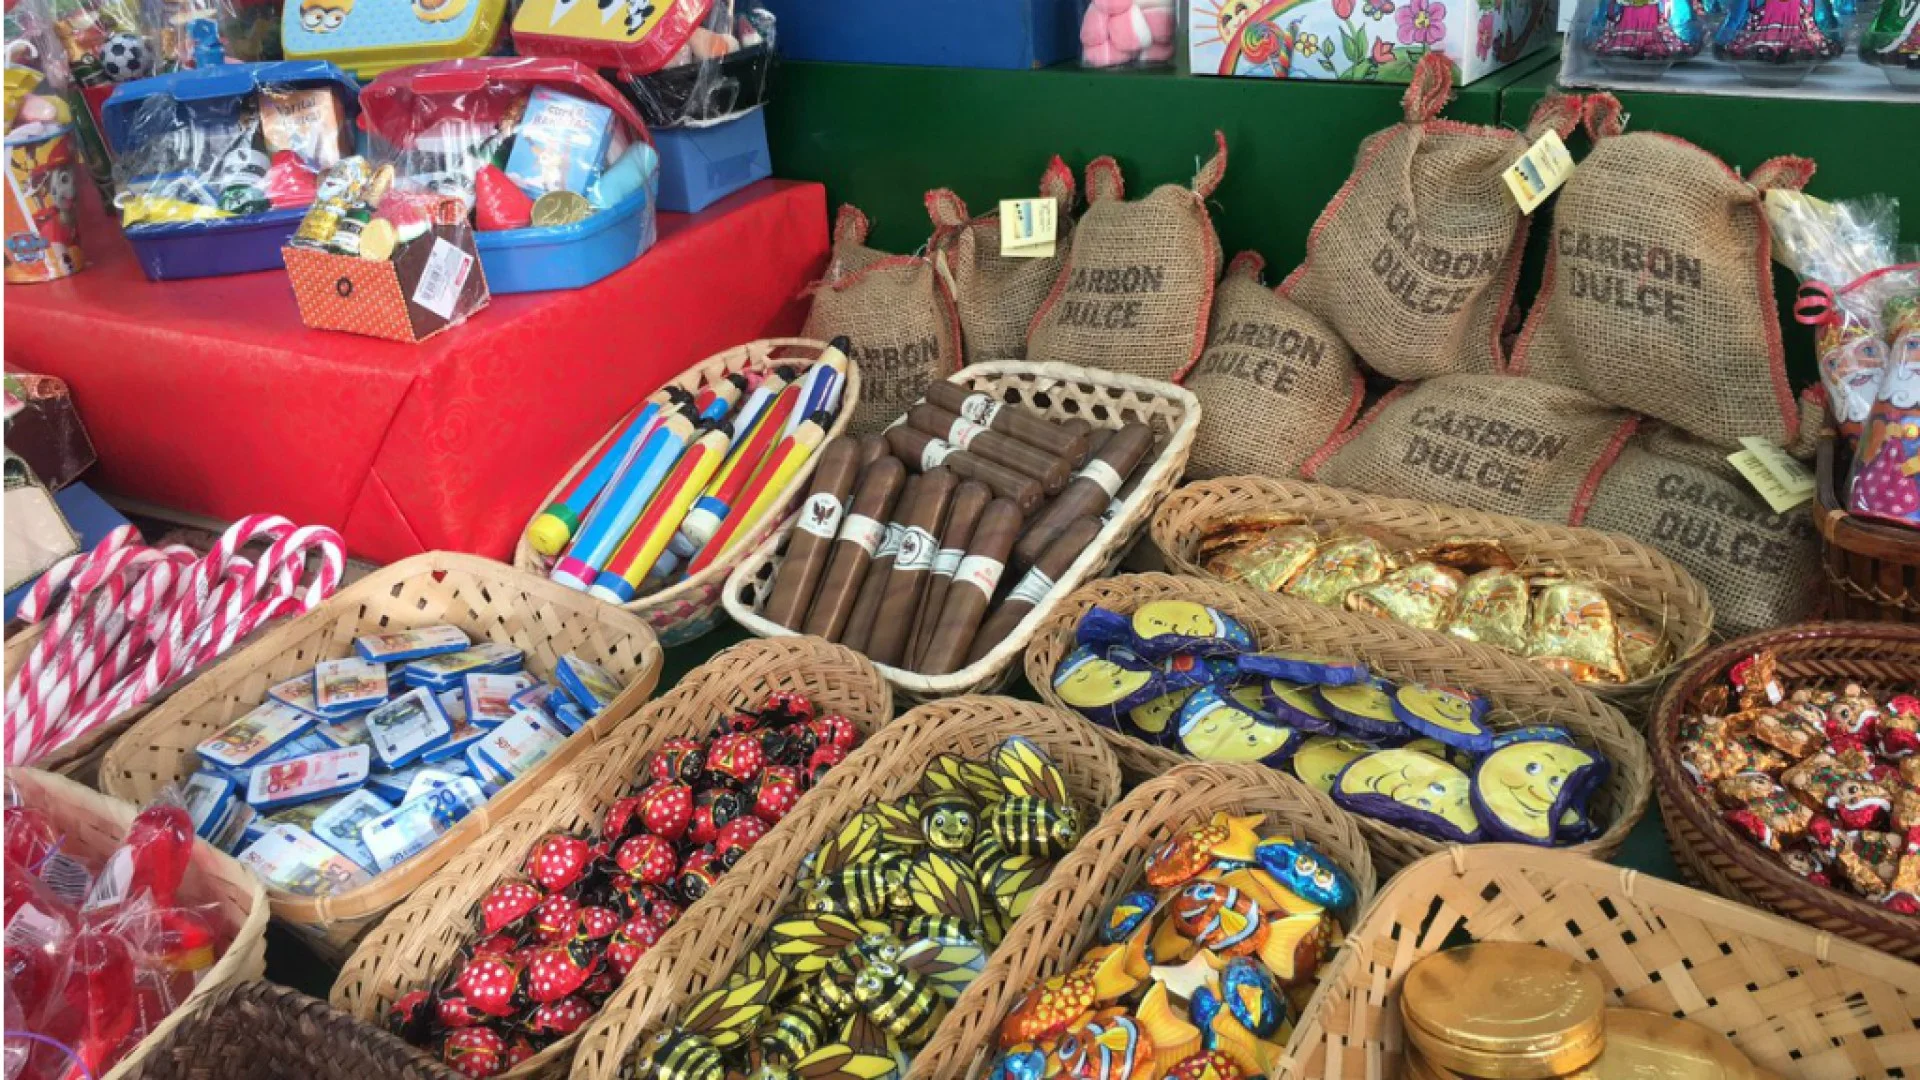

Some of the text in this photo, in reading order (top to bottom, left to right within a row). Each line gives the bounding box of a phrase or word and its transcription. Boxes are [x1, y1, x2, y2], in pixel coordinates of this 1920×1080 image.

[1372, 245, 1475, 315] DULCE
[1559, 228, 1701, 289] CARBON
[1057, 300, 1142, 329] DULCE
[1569, 267, 1685, 325] DULCE
[850, 335, 940, 370] ARBON
[1200, 351, 1299, 394] DULCE
[1411, 405, 1569, 462] CARBON
[1402, 434, 1528, 496] DULCE
[1653, 510, 1790, 575] DULCE
[429, 788, 457, 813] 20
